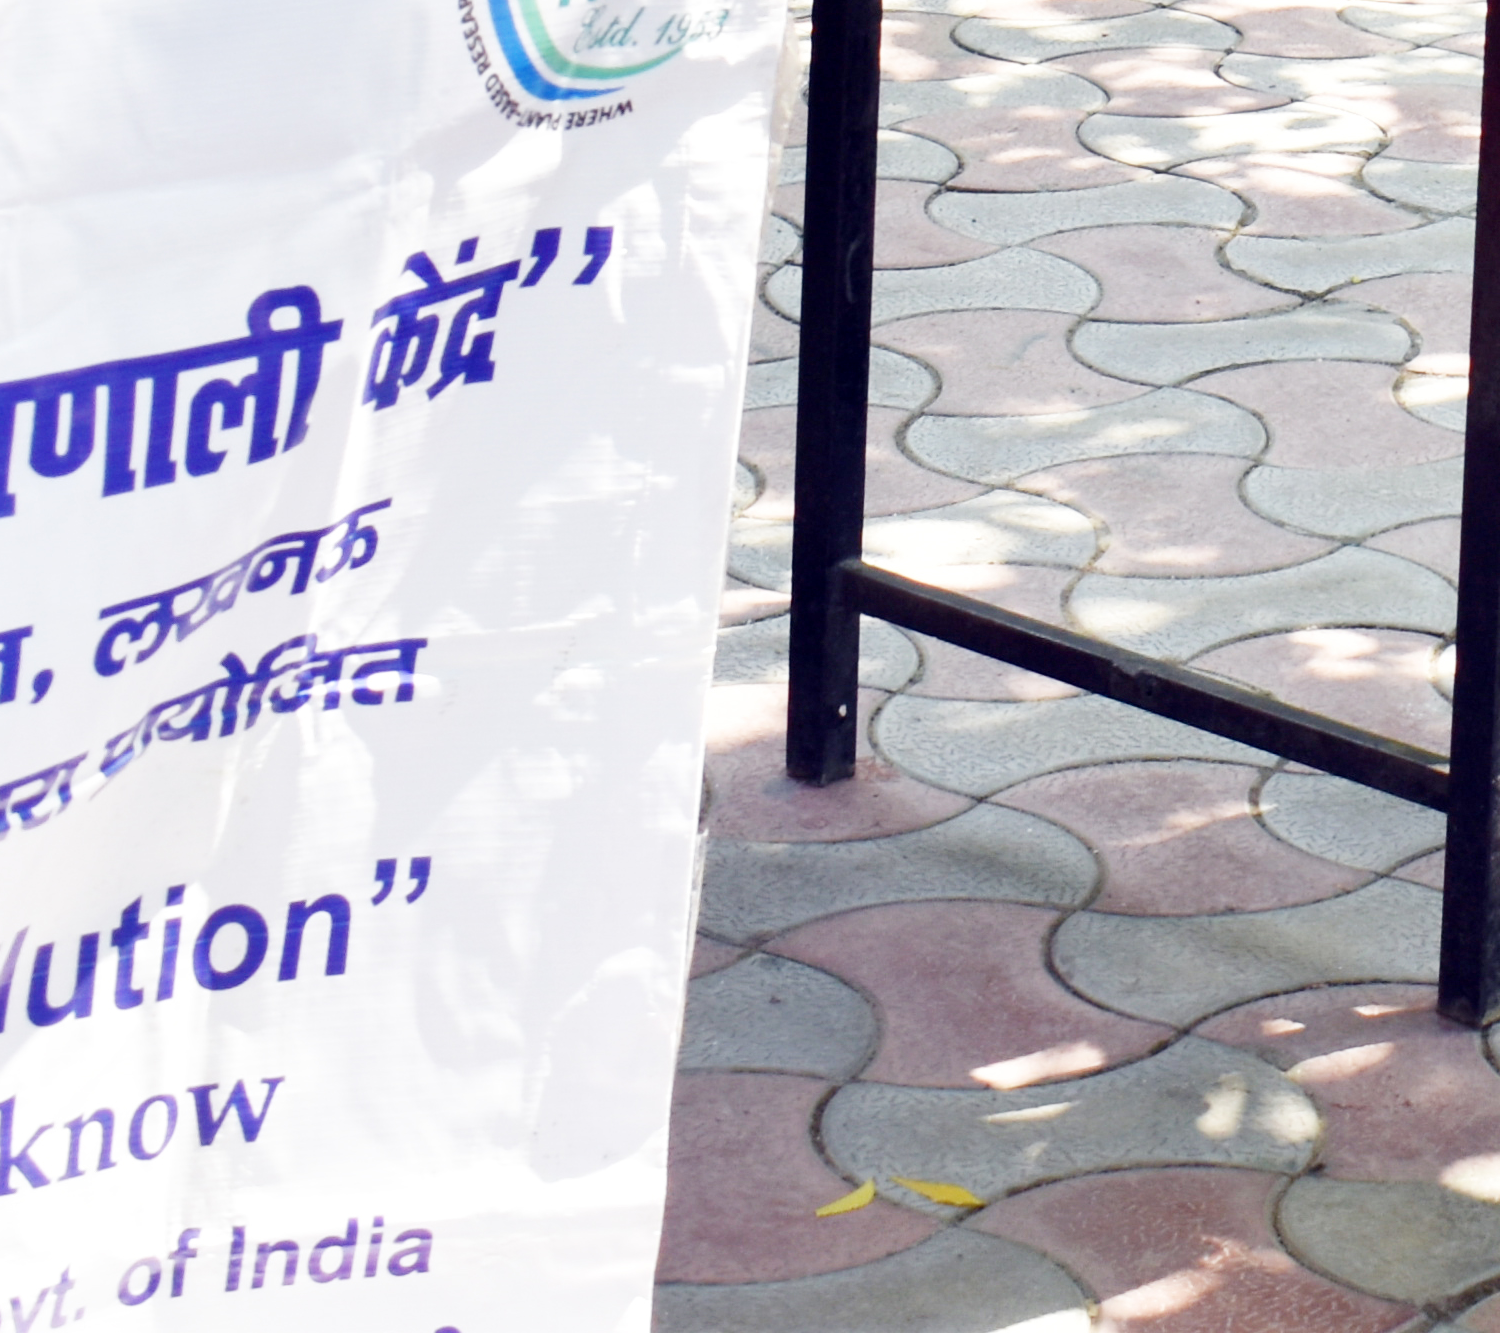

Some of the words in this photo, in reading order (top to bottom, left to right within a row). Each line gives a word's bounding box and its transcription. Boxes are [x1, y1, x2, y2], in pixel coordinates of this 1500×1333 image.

[573, 6, 638, 54] Estd.
[653, 8, 730, 46] 1953
[563, 98, 634, 131] WHERE
[94, 497, 393, 677] लखनऊ
[116, 1226, 201, 1307] of
[224, 1215, 434, 1292] India
